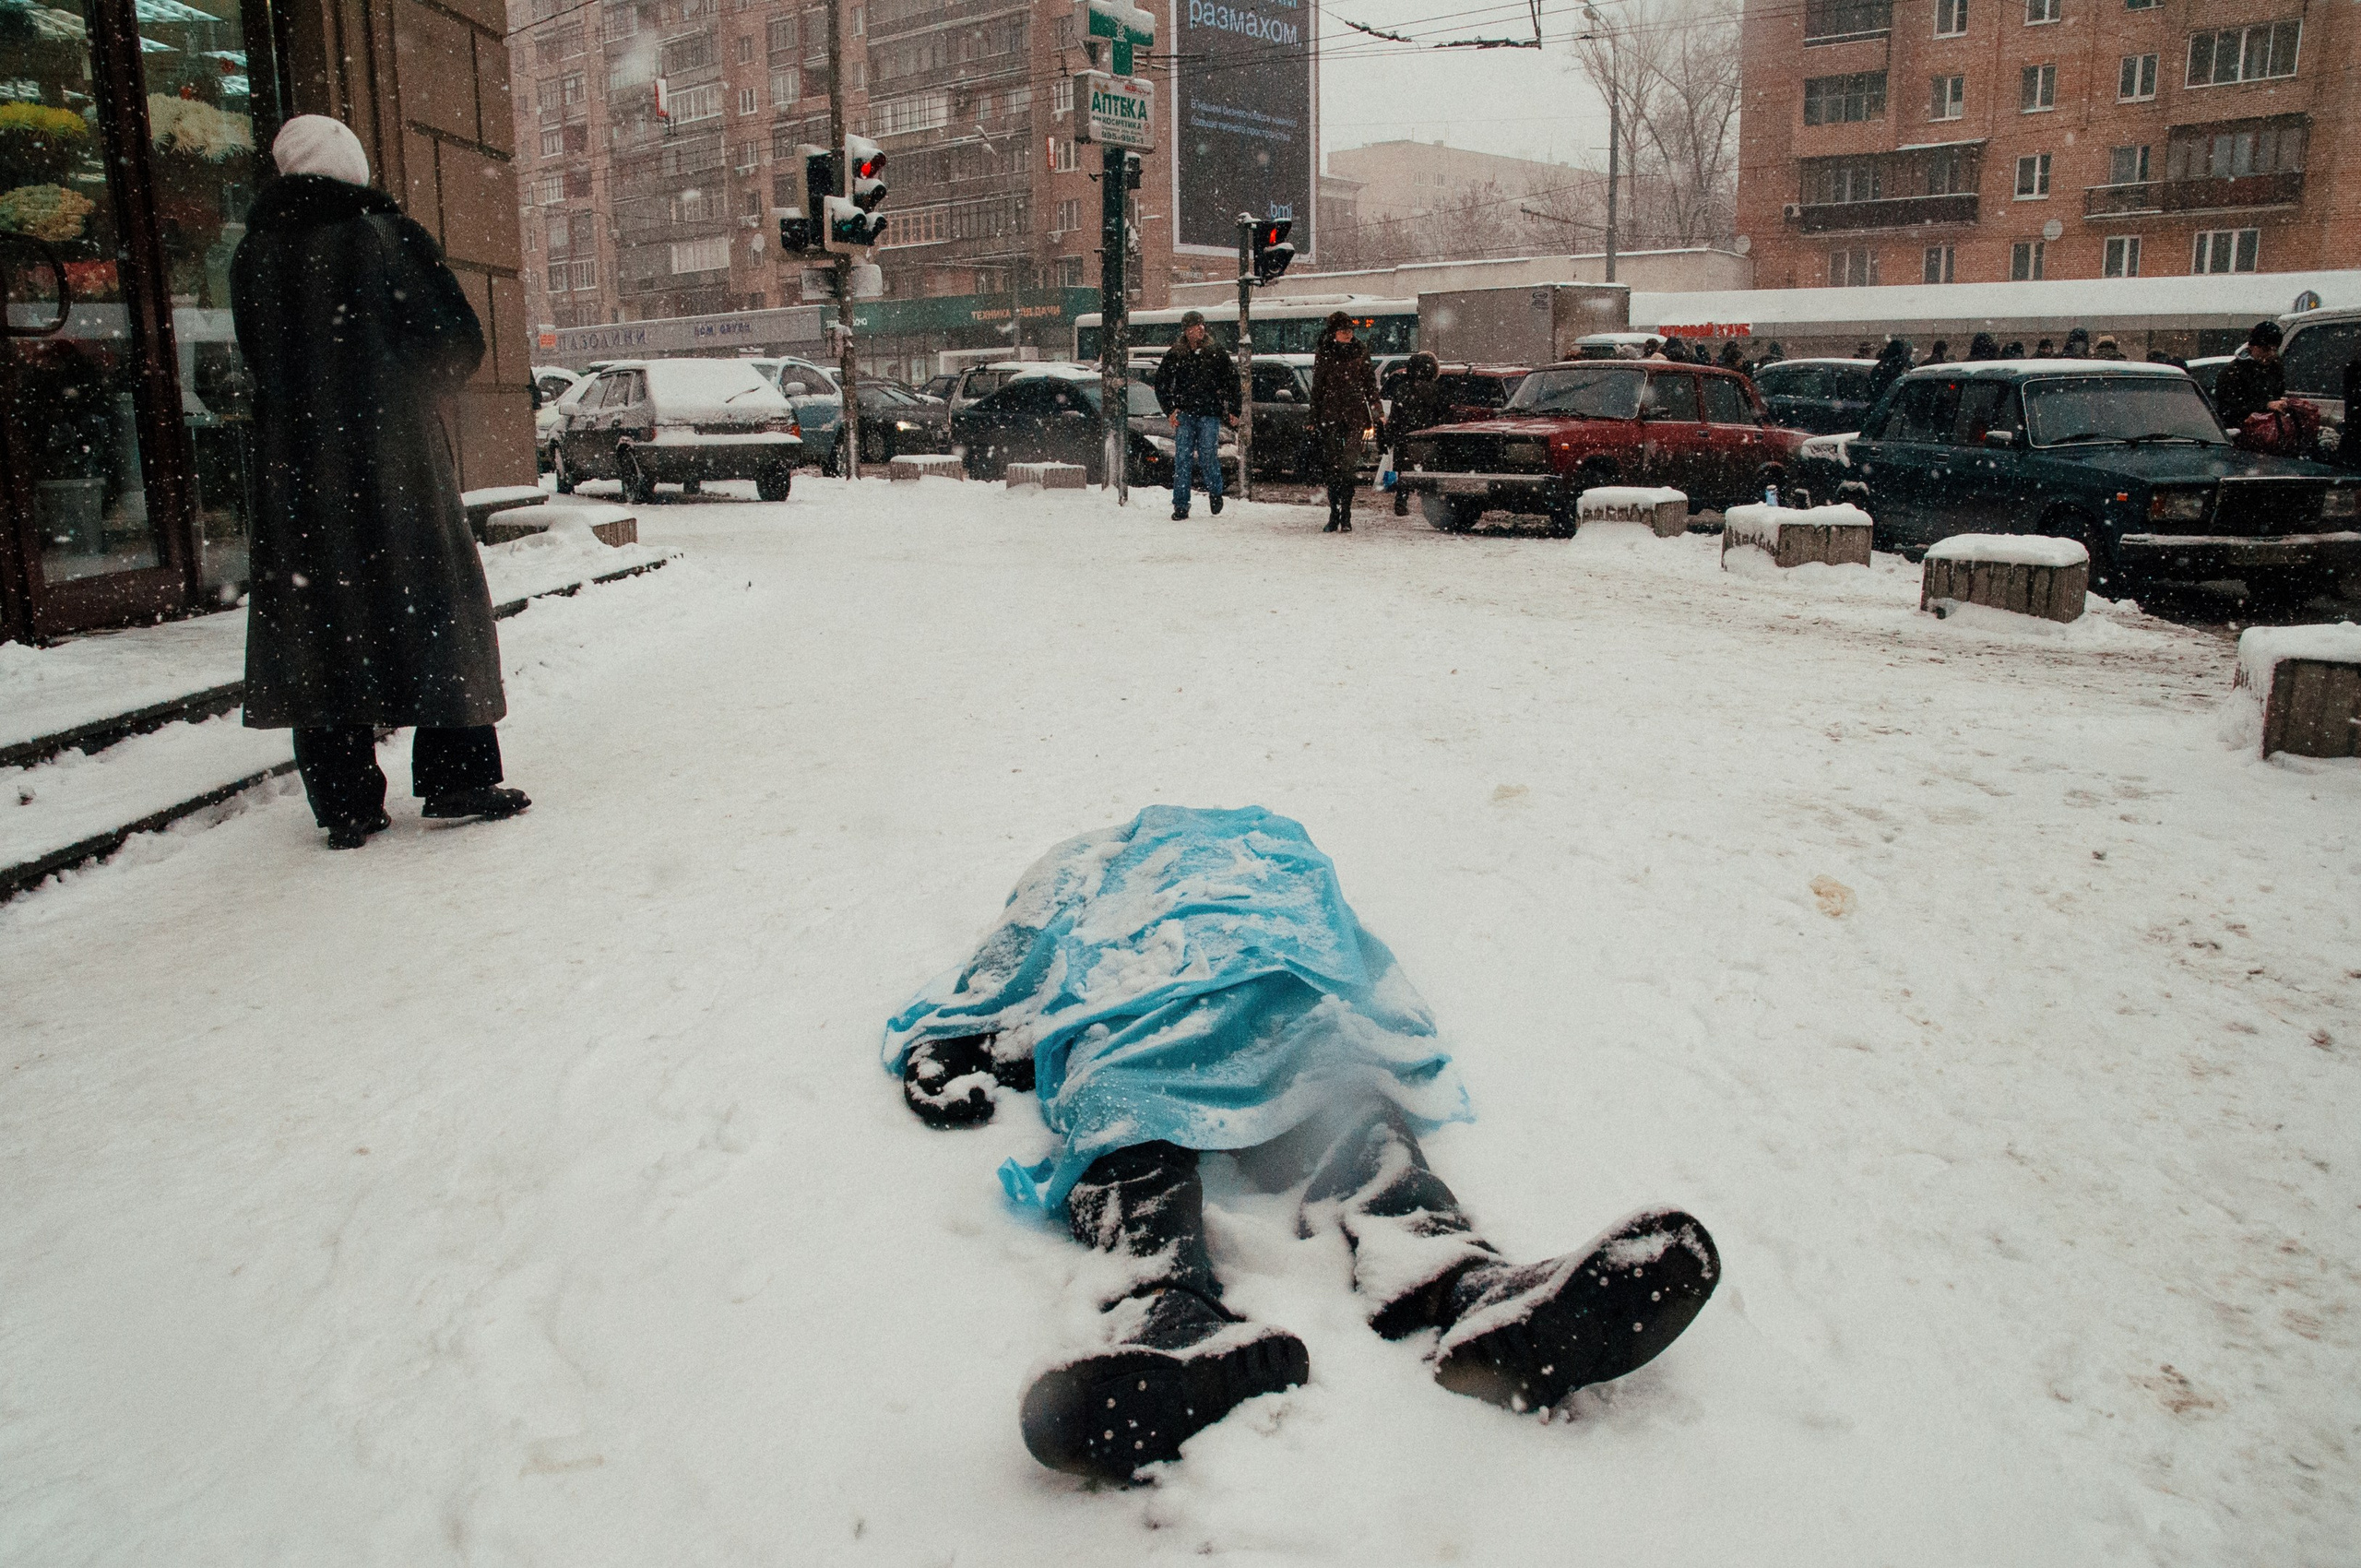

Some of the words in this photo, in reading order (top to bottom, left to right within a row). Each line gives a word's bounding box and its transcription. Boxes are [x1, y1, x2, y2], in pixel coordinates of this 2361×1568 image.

[1092, 91, 1147, 121] АПТЕКА
[1102, 116, 1142, 130] КОСМЕТИКА
[1270, 200, 1292, 219] bmi
[971, 308, 1012, 321] ТЕХНИКА
[558, 328, 647, 351] ПАЗОЛИНИ
